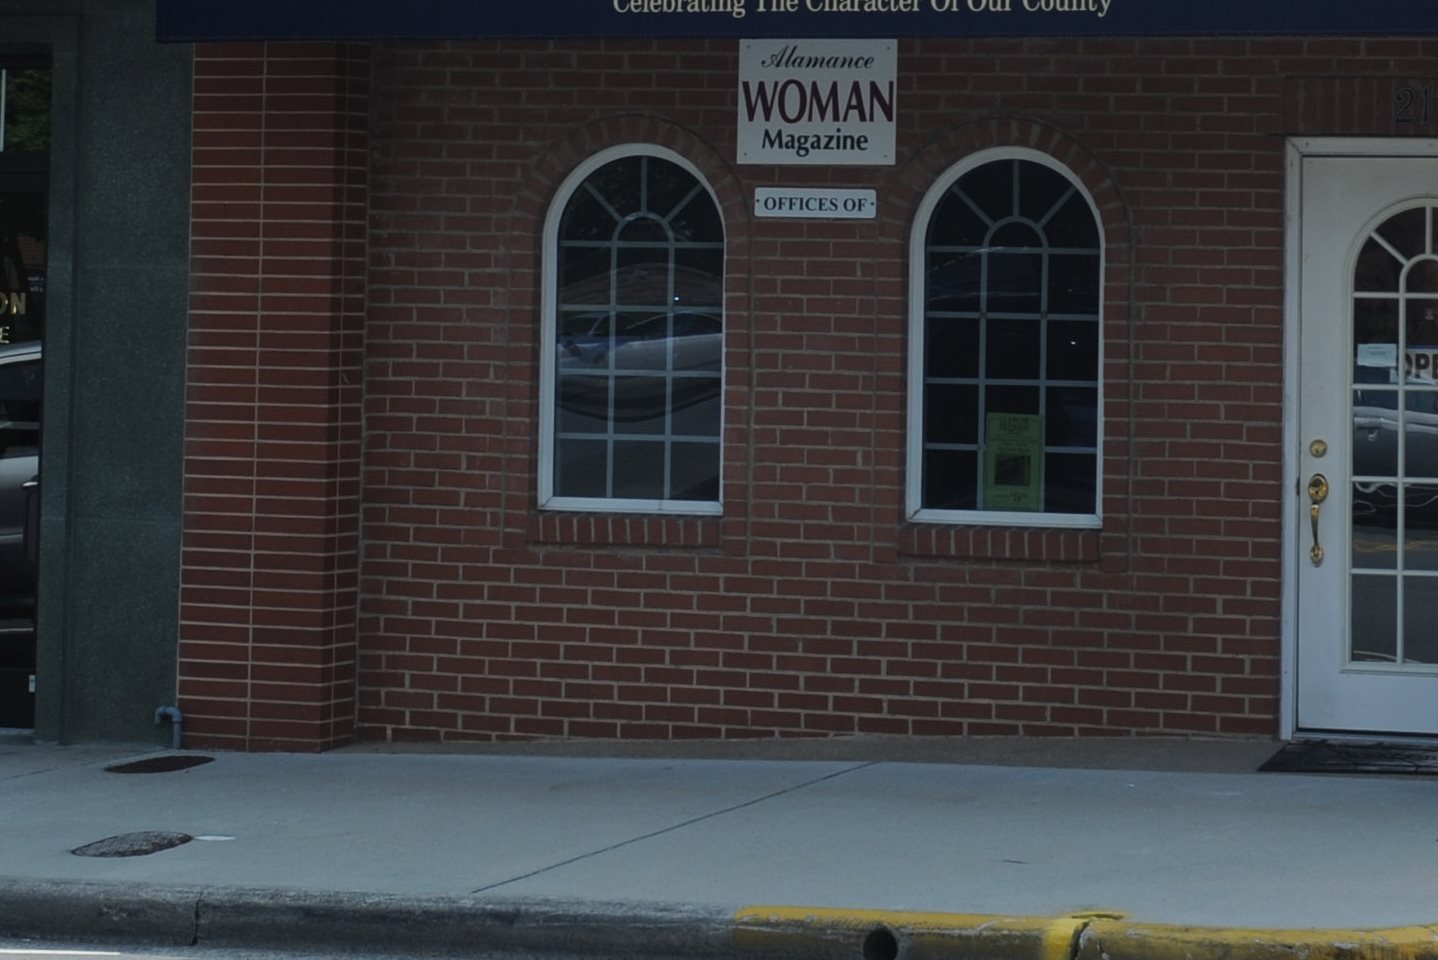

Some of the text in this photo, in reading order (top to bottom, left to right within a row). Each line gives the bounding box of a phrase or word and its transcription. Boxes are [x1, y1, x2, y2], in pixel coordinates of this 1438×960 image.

[761, 45, 875, 69] Alamance
[741, 78, 894, 124] WOMAN
[761, 127, 869, 157] Magazine
[763, 196, 867, 212] OFFICES OF
